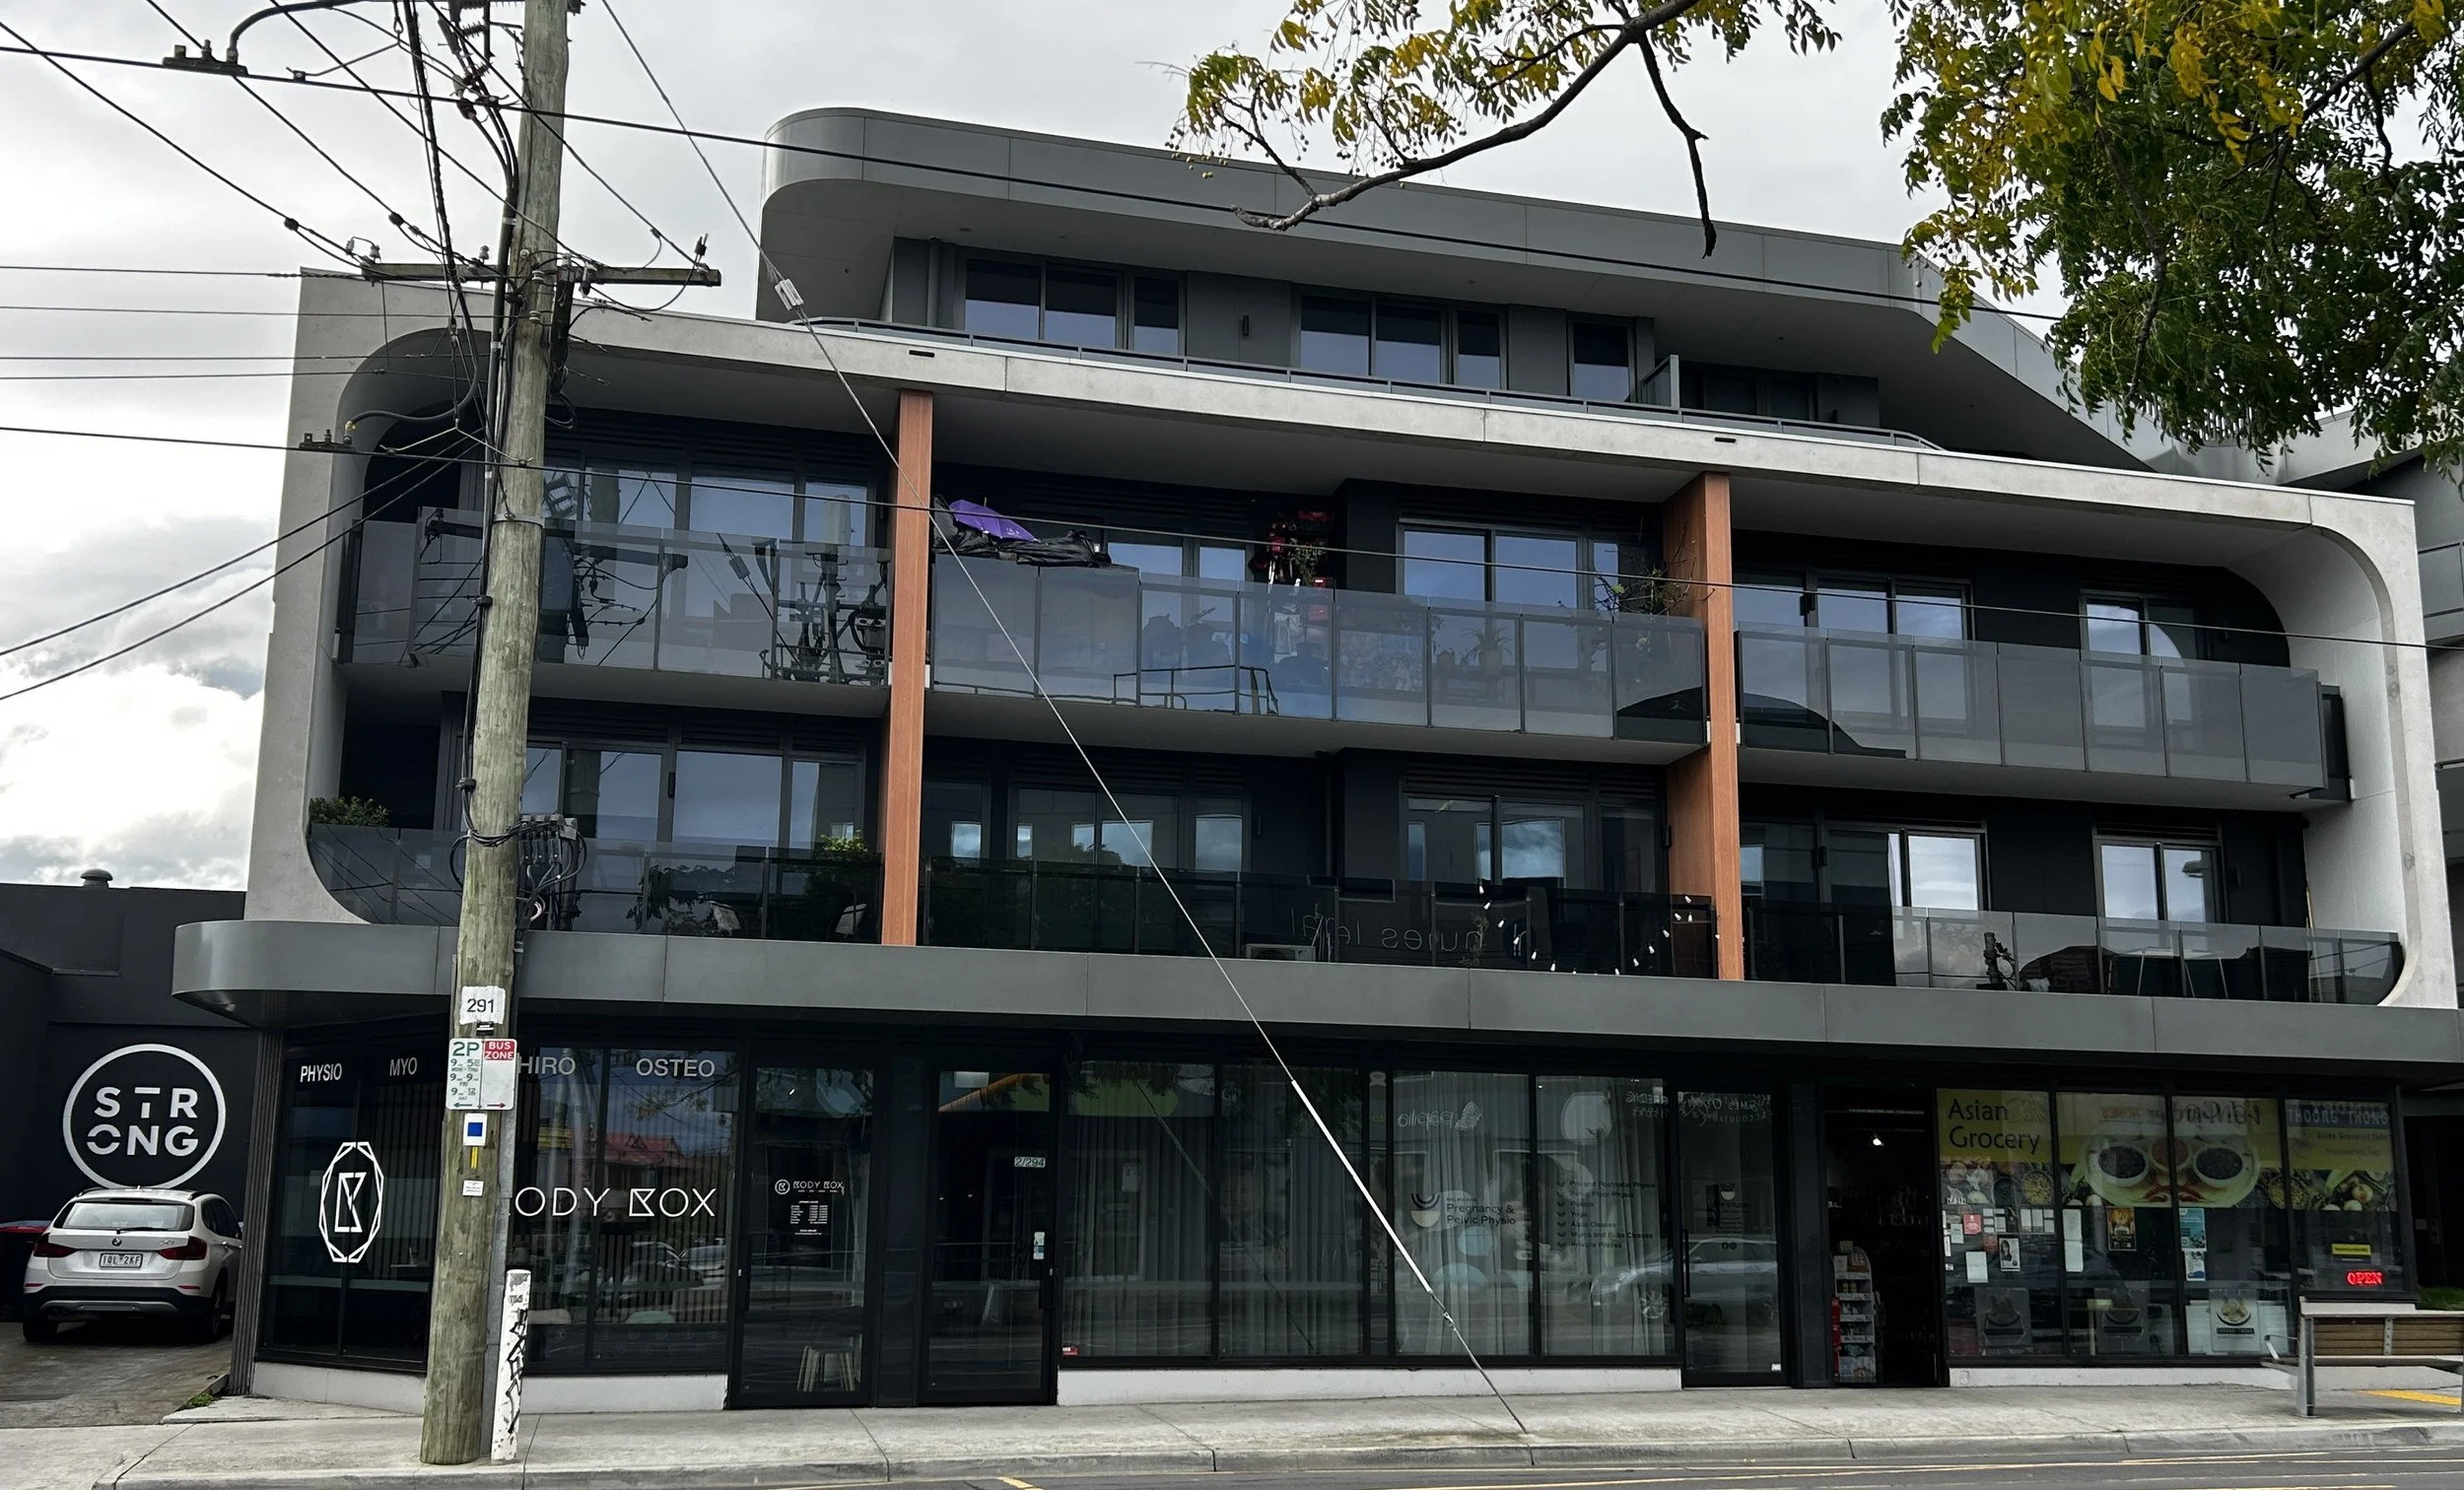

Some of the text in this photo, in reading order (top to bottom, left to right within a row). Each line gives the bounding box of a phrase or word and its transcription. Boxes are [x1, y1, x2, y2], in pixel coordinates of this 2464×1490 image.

[466, 998, 494, 1013] 291
[452, 1042, 480, 1056] 2P
[489, 1042, 512, 1050] BUS
[300, 1063, 343, 1083] PHYSIO
[389, 1056, 418, 1077] MYO
[516, 1055, 577, 1075] HIRO
[636, 1057, 716, 1077] OSTEO
[1948, 1098, 2008, 1120] Asian
[1950, 1125, 2040, 1155] Grocery
[1015, 1157, 1045, 1168] 2/294
[514, 1186, 610, 1217] ODY
[1446, 1203, 1515, 1216] Pregnancy &
[1446, 1215, 1516, 1227] Pelvic Physio
[2346, 1271, 2383, 1285] OPEN
